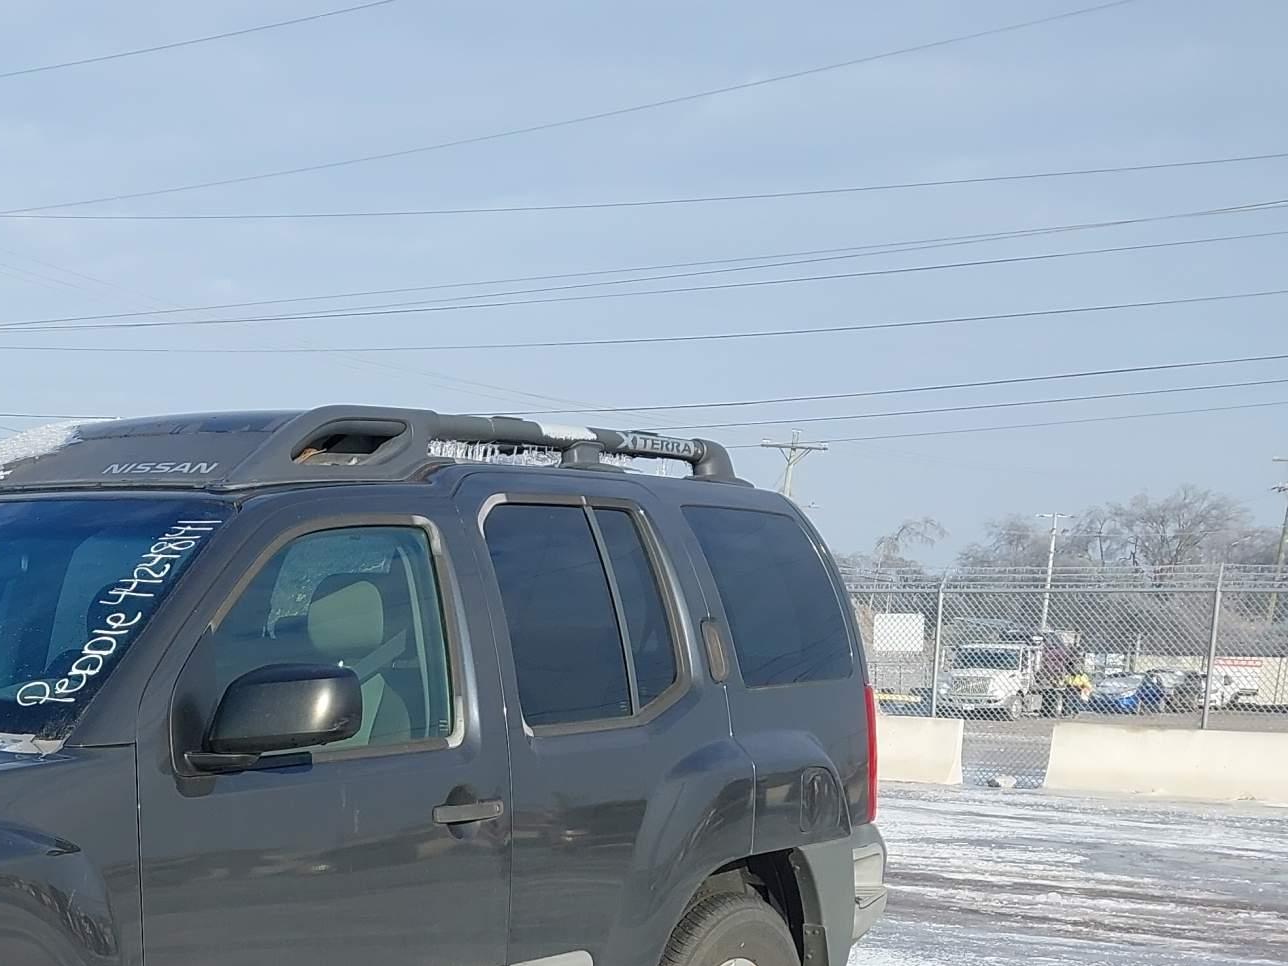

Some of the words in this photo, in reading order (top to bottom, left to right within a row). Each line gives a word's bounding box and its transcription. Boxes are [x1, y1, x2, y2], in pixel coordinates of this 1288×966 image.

[616, 431, 692, 455] XTERRA
[102, 462, 219, 474] NISSAN
[99, 520, 223, 605] 44248141
